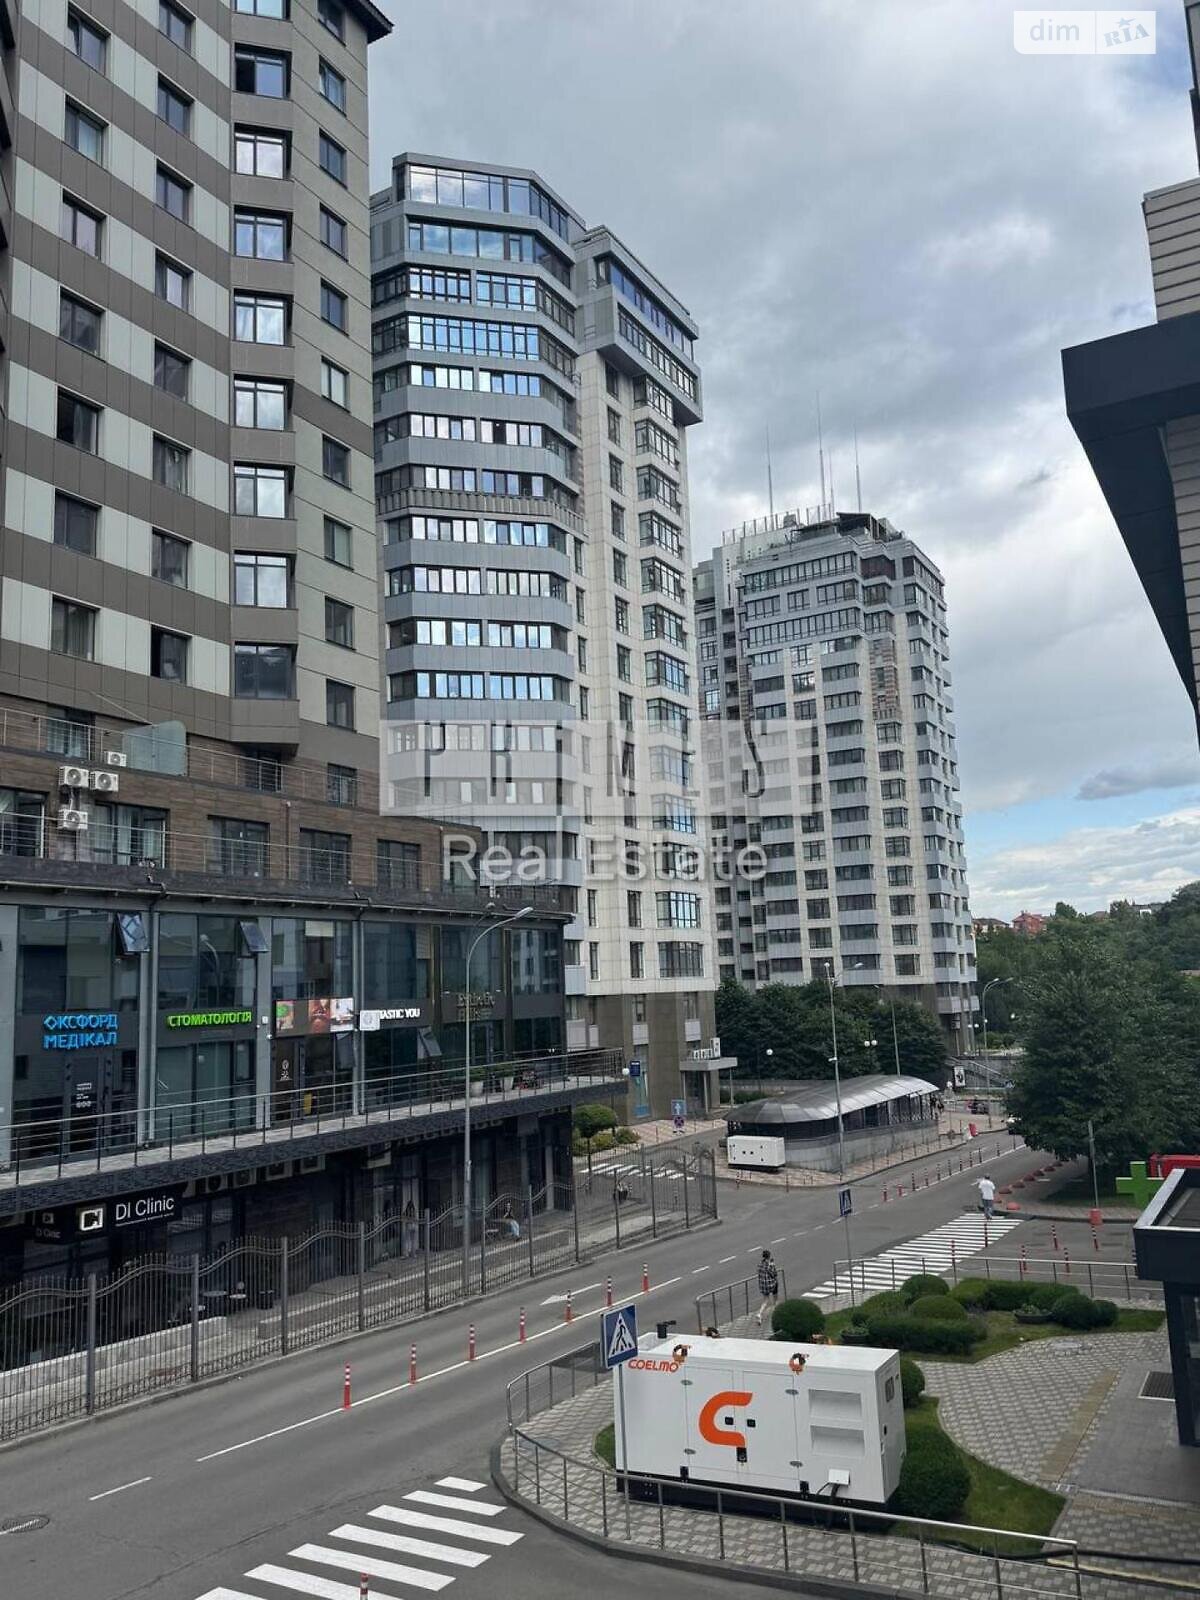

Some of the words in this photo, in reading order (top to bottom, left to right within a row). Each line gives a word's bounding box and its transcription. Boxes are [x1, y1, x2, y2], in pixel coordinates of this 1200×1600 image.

[405, 1008, 420, 1017] YOU
[43, 1014, 118, 1030] ОКСФОРД
[43, 1032, 118, 1049] МЕДІКАЛ
[135, 1195, 175, 1216] Clinic
[628, 1359, 679, 1373] COELMO
